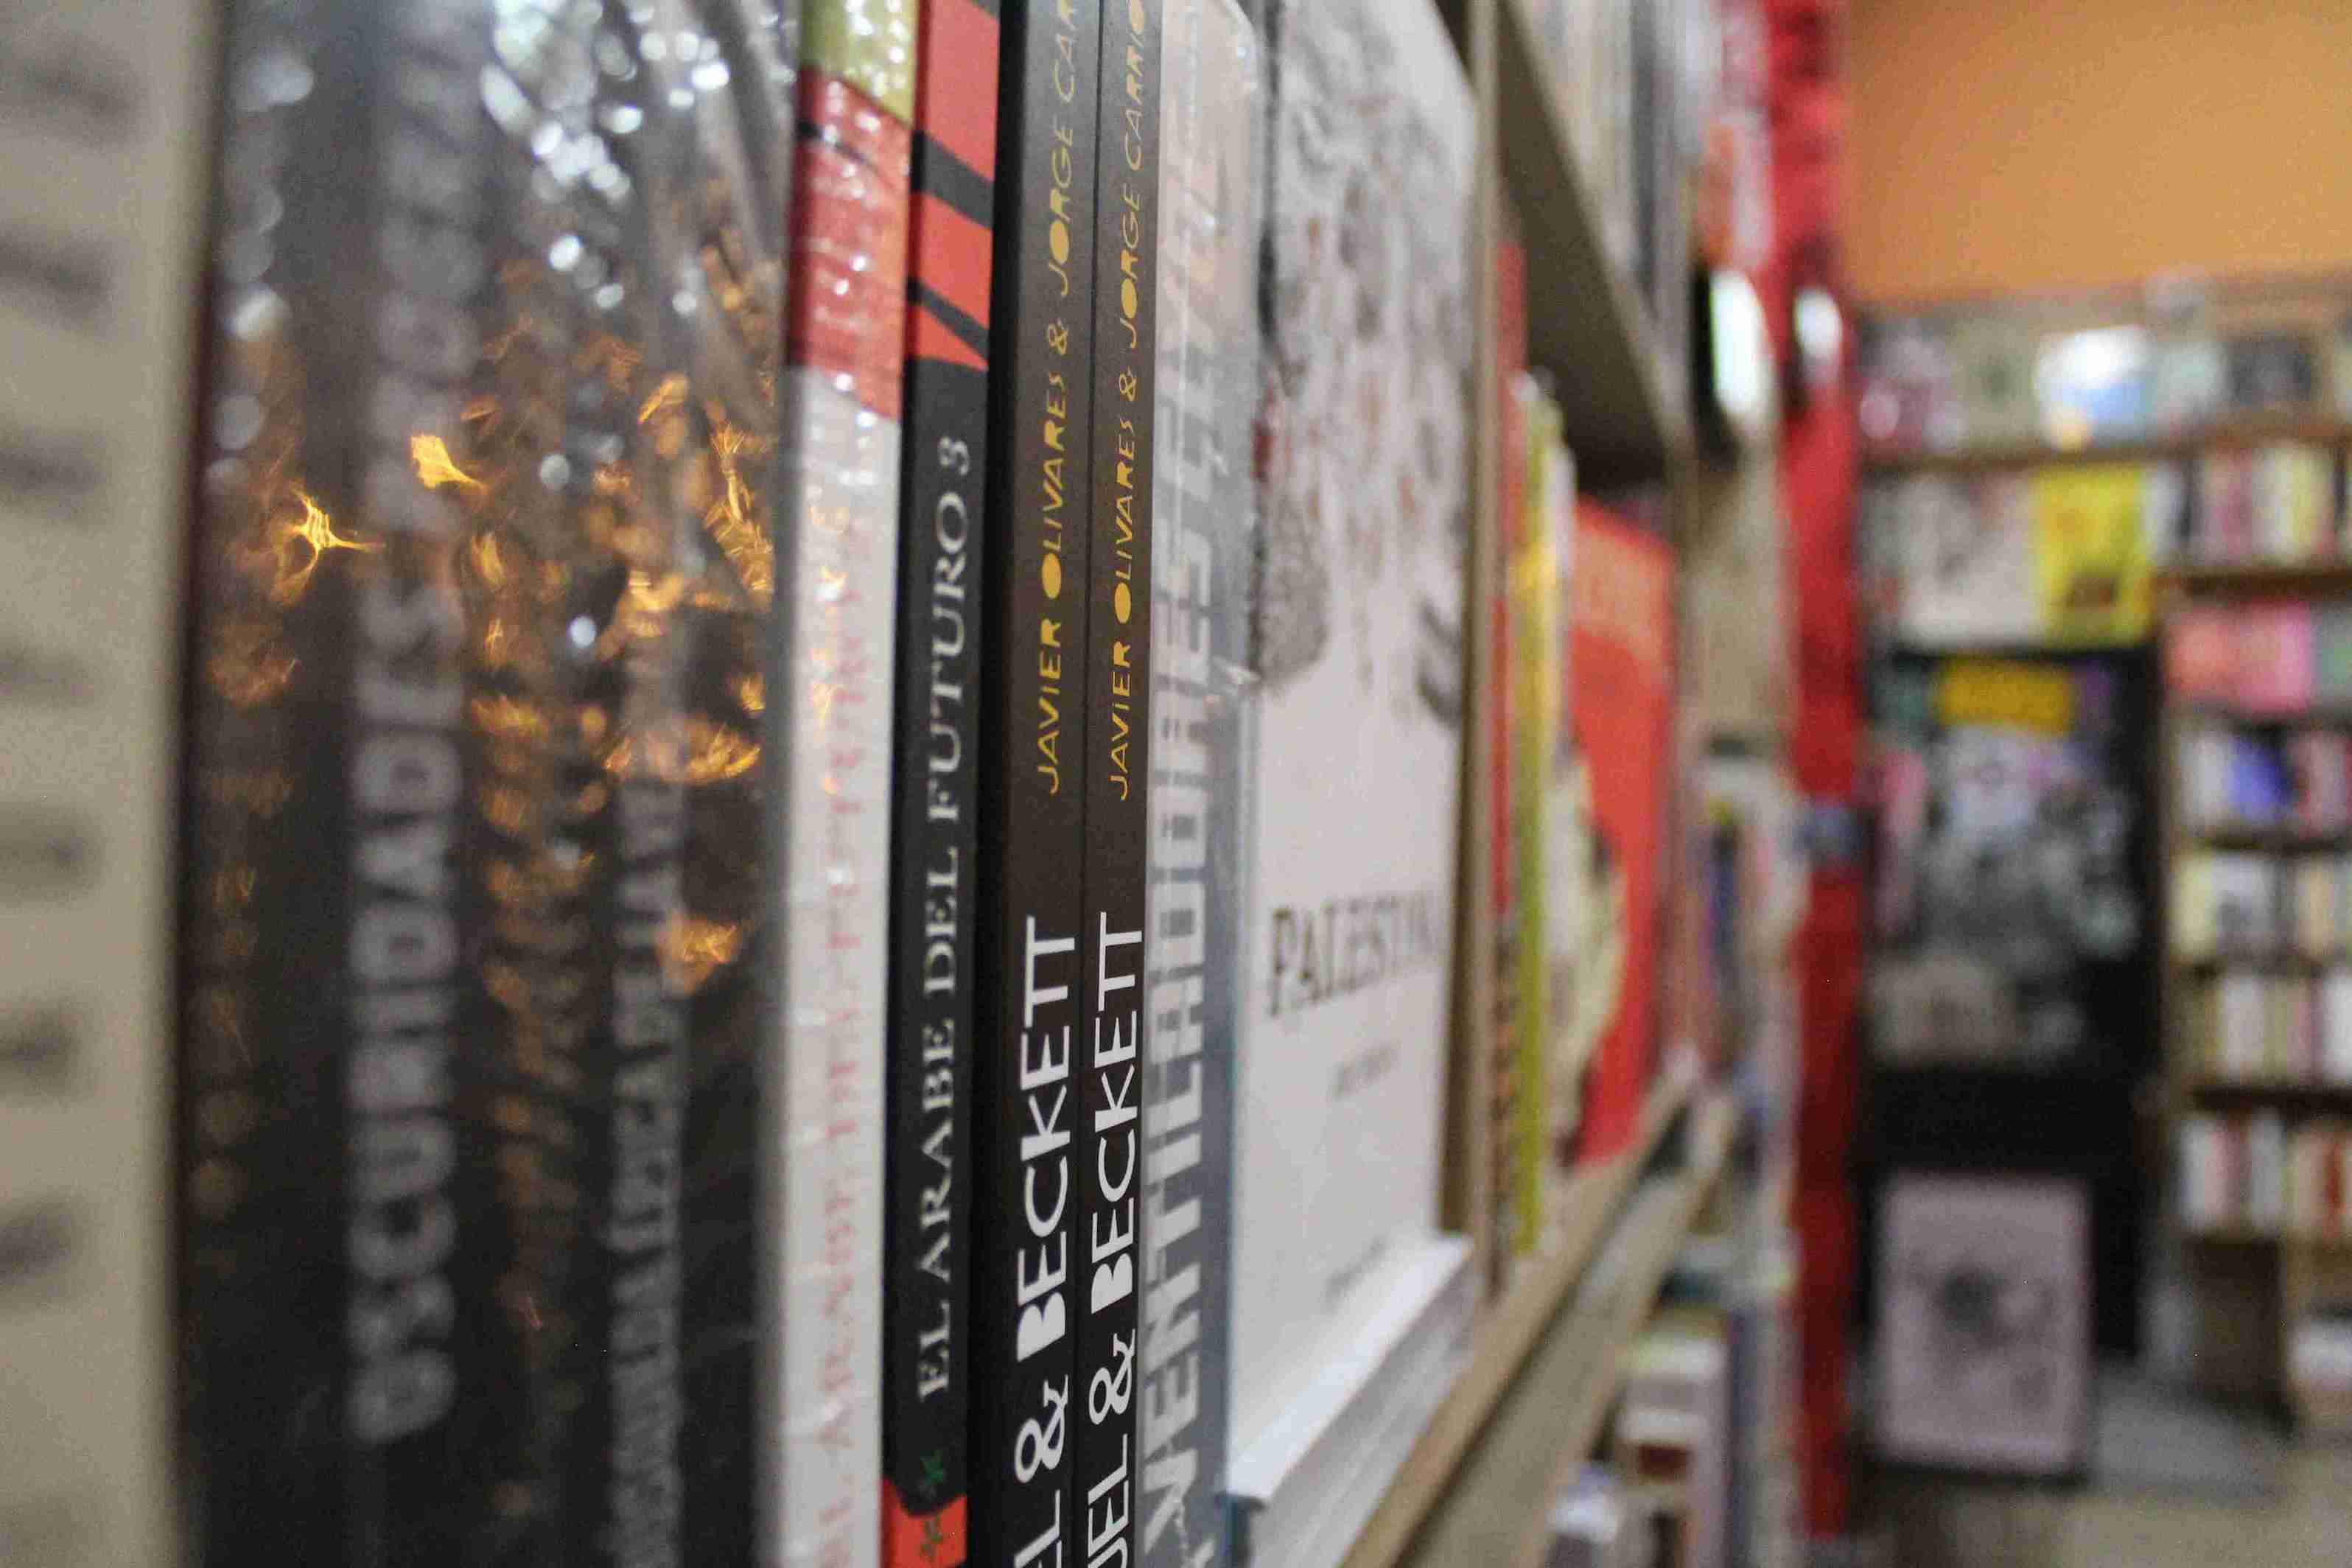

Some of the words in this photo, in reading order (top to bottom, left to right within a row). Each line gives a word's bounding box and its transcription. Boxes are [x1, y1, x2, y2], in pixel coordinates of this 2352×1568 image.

[1049, 109, 1075, 295] JORGE
[1119, 183, 1142, 348] JORGE
[1047, 315, 1070, 354] &
[1118, 369, 1138, 402] &
[937, 435, 970, 477] 3
[928, 490, 967, 822] FUTURO
[923, 846, 959, 993] DEL
[1143, 512, 1210, 1555] VENTILADORES
[920, 1019, 954, 1282] ARABE
[1018, 916, 1075, 1362] BECKETT
[1091, 911, 1142, 1315] BECKETT
[919, 1301, 950, 1398] EL
[1088, 1329, 1135, 1425] &
[1015, 1374, 1068, 1483] &
